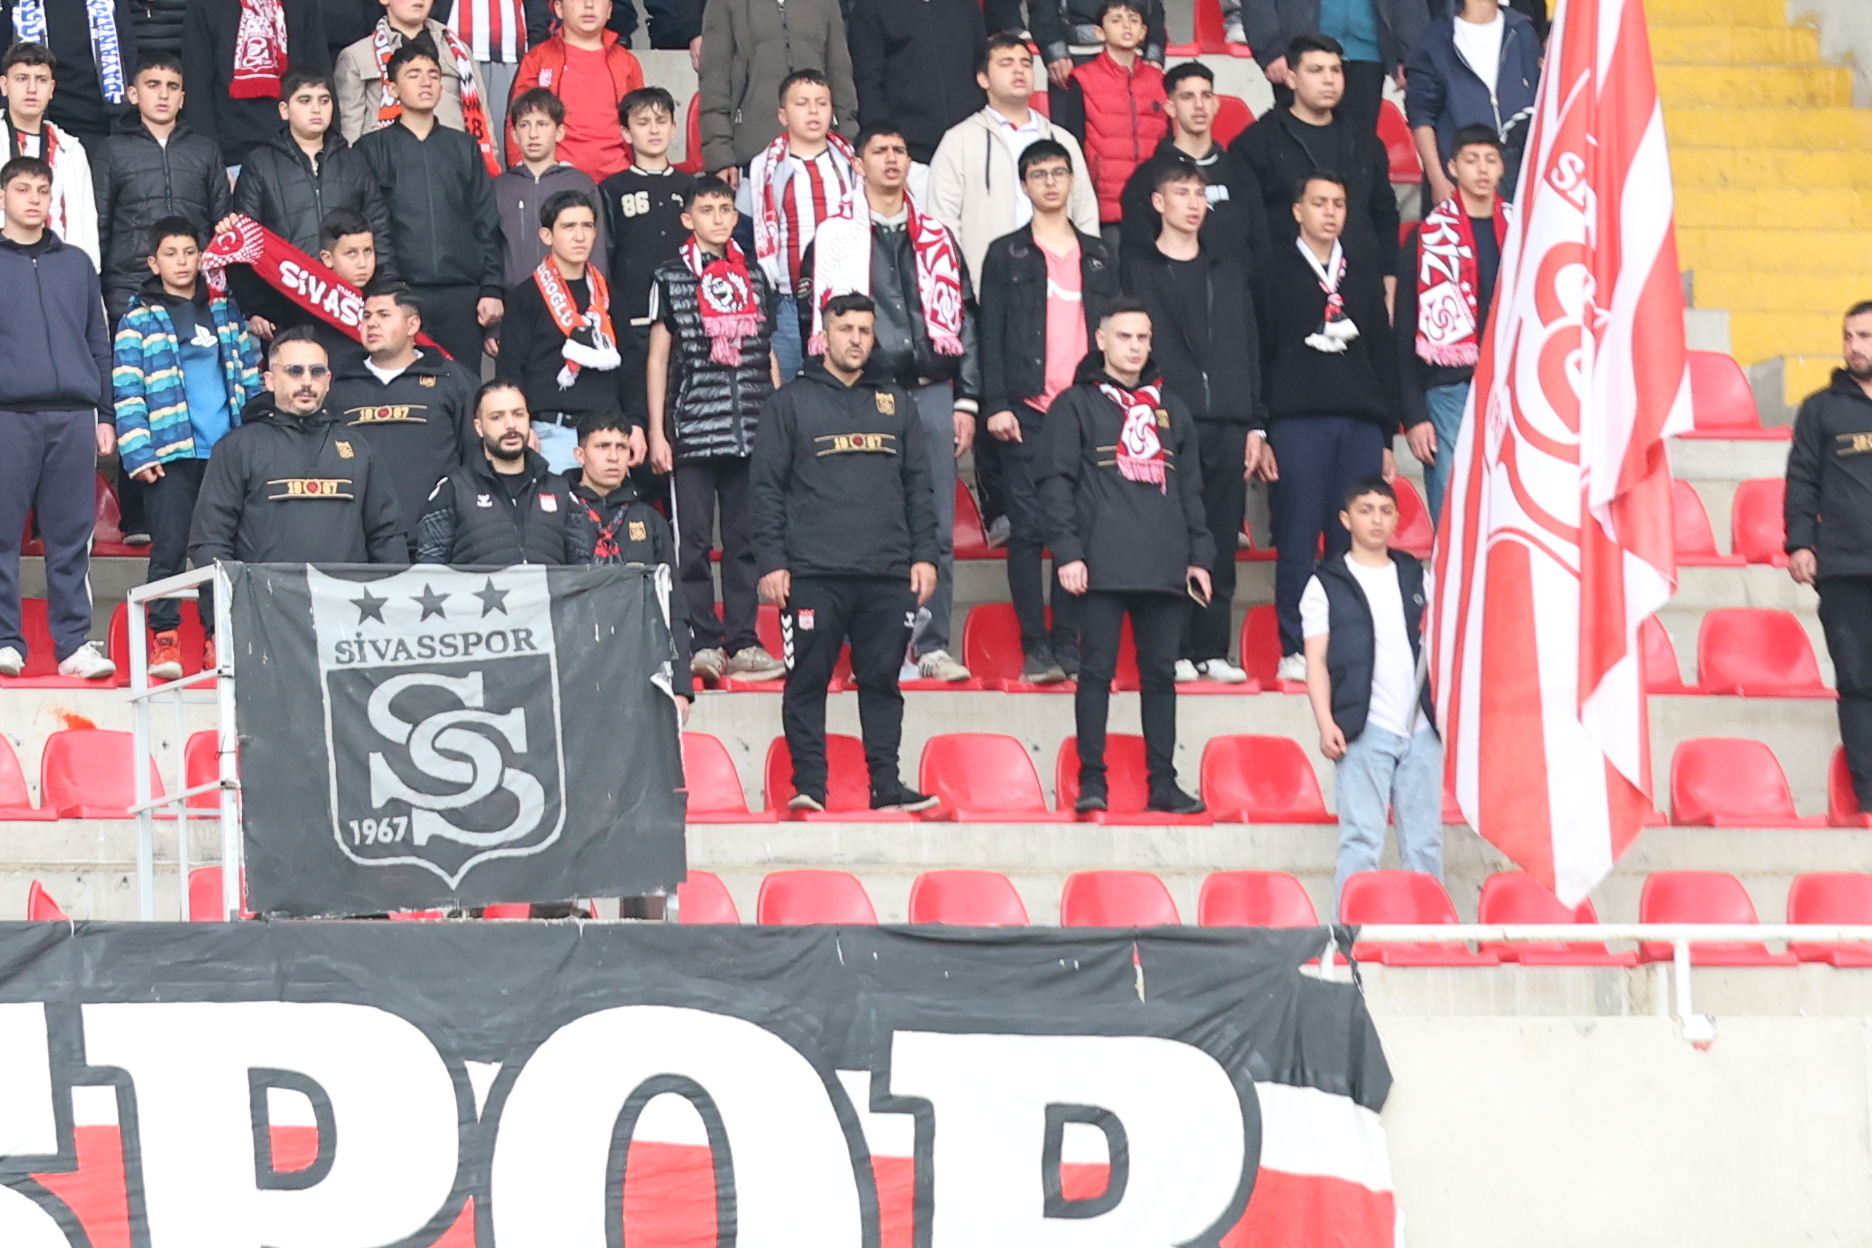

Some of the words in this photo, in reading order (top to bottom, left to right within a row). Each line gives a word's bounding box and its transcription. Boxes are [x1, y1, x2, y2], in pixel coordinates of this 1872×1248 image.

[621, 190, 650, 218] 86
[334, 627, 538, 665] SİVASSPOR
[348, 816, 409, 847] 1967
